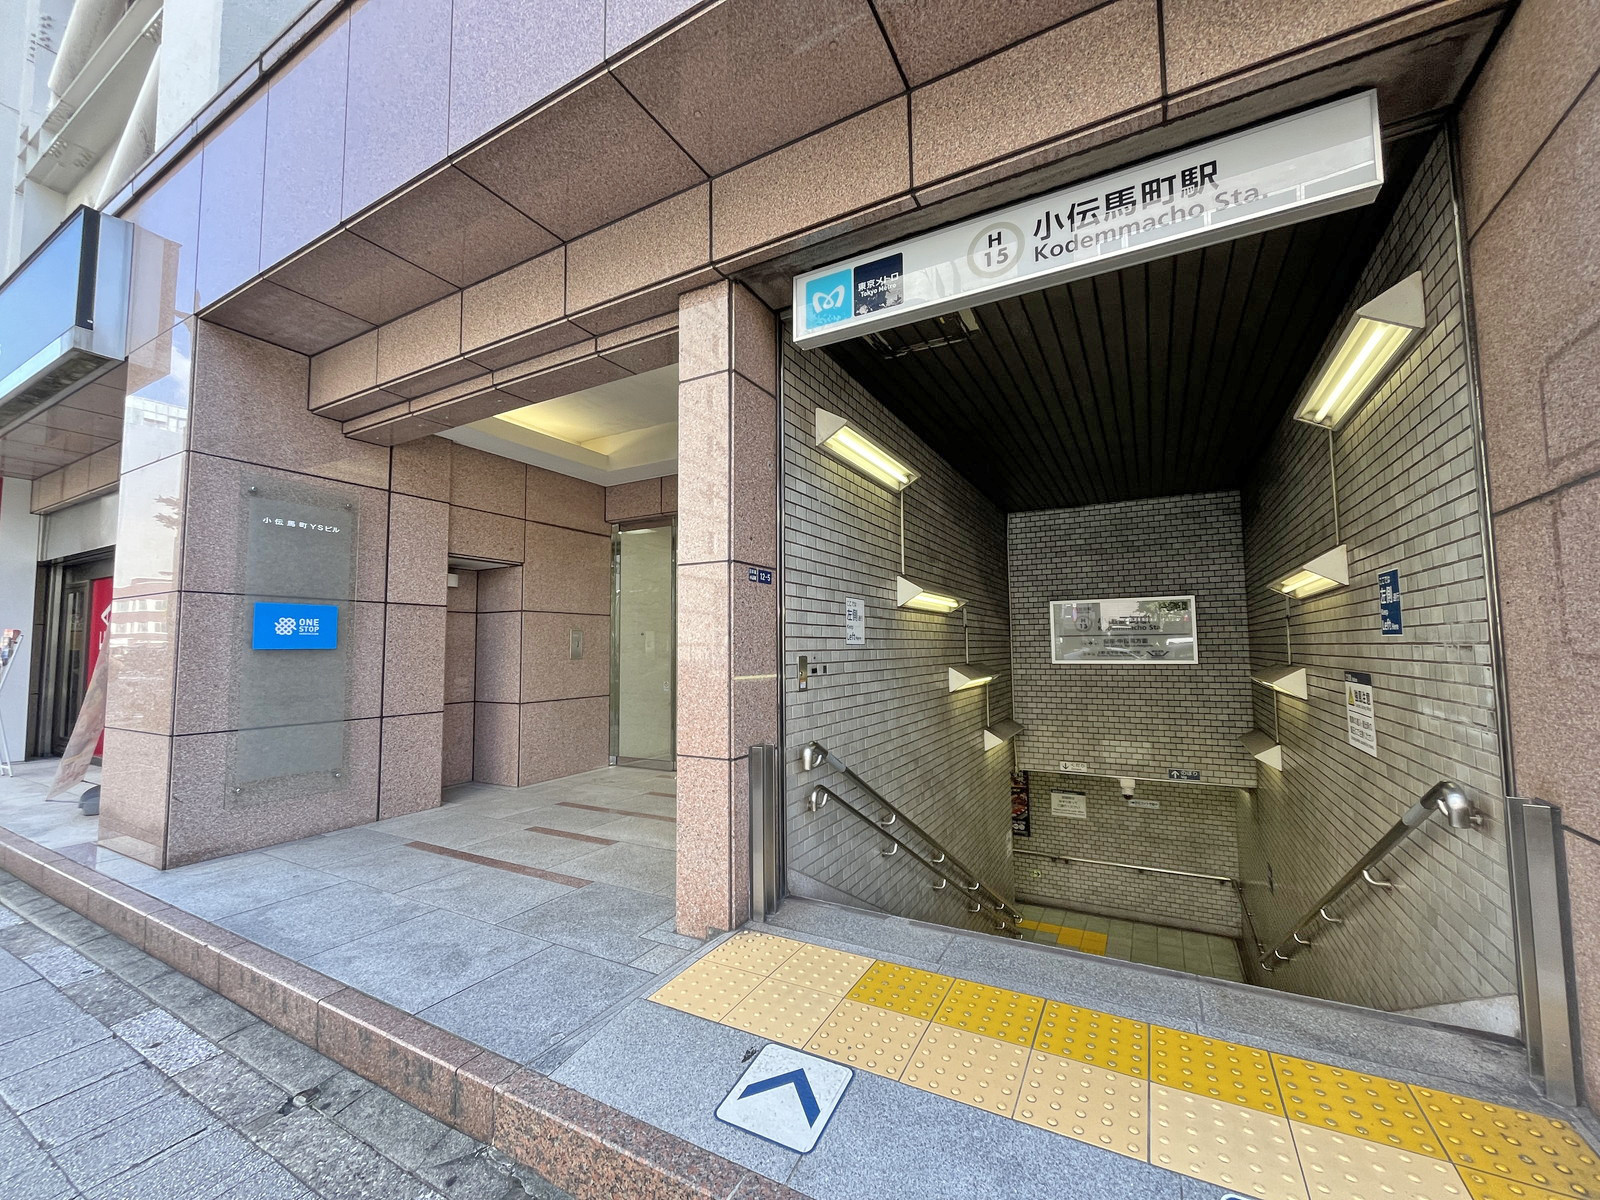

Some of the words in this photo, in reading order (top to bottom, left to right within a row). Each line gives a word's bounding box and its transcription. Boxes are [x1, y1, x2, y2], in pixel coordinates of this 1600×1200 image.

[1033, 160, 1219, 241] 小伝馬町駅
[1034, 203, 1205, 262] Kodemmacho
[1215, 186, 1268, 211] Sta.
[988, 231, 1002, 249] H
[984, 246, 1009, 267] 15
[857, 272, 899, 292] 東京メトロ
[860, 288, 878, 298] Tokyo
[878, 283, 897, 293] Metro
[298, 618, 320, 626] ONE
